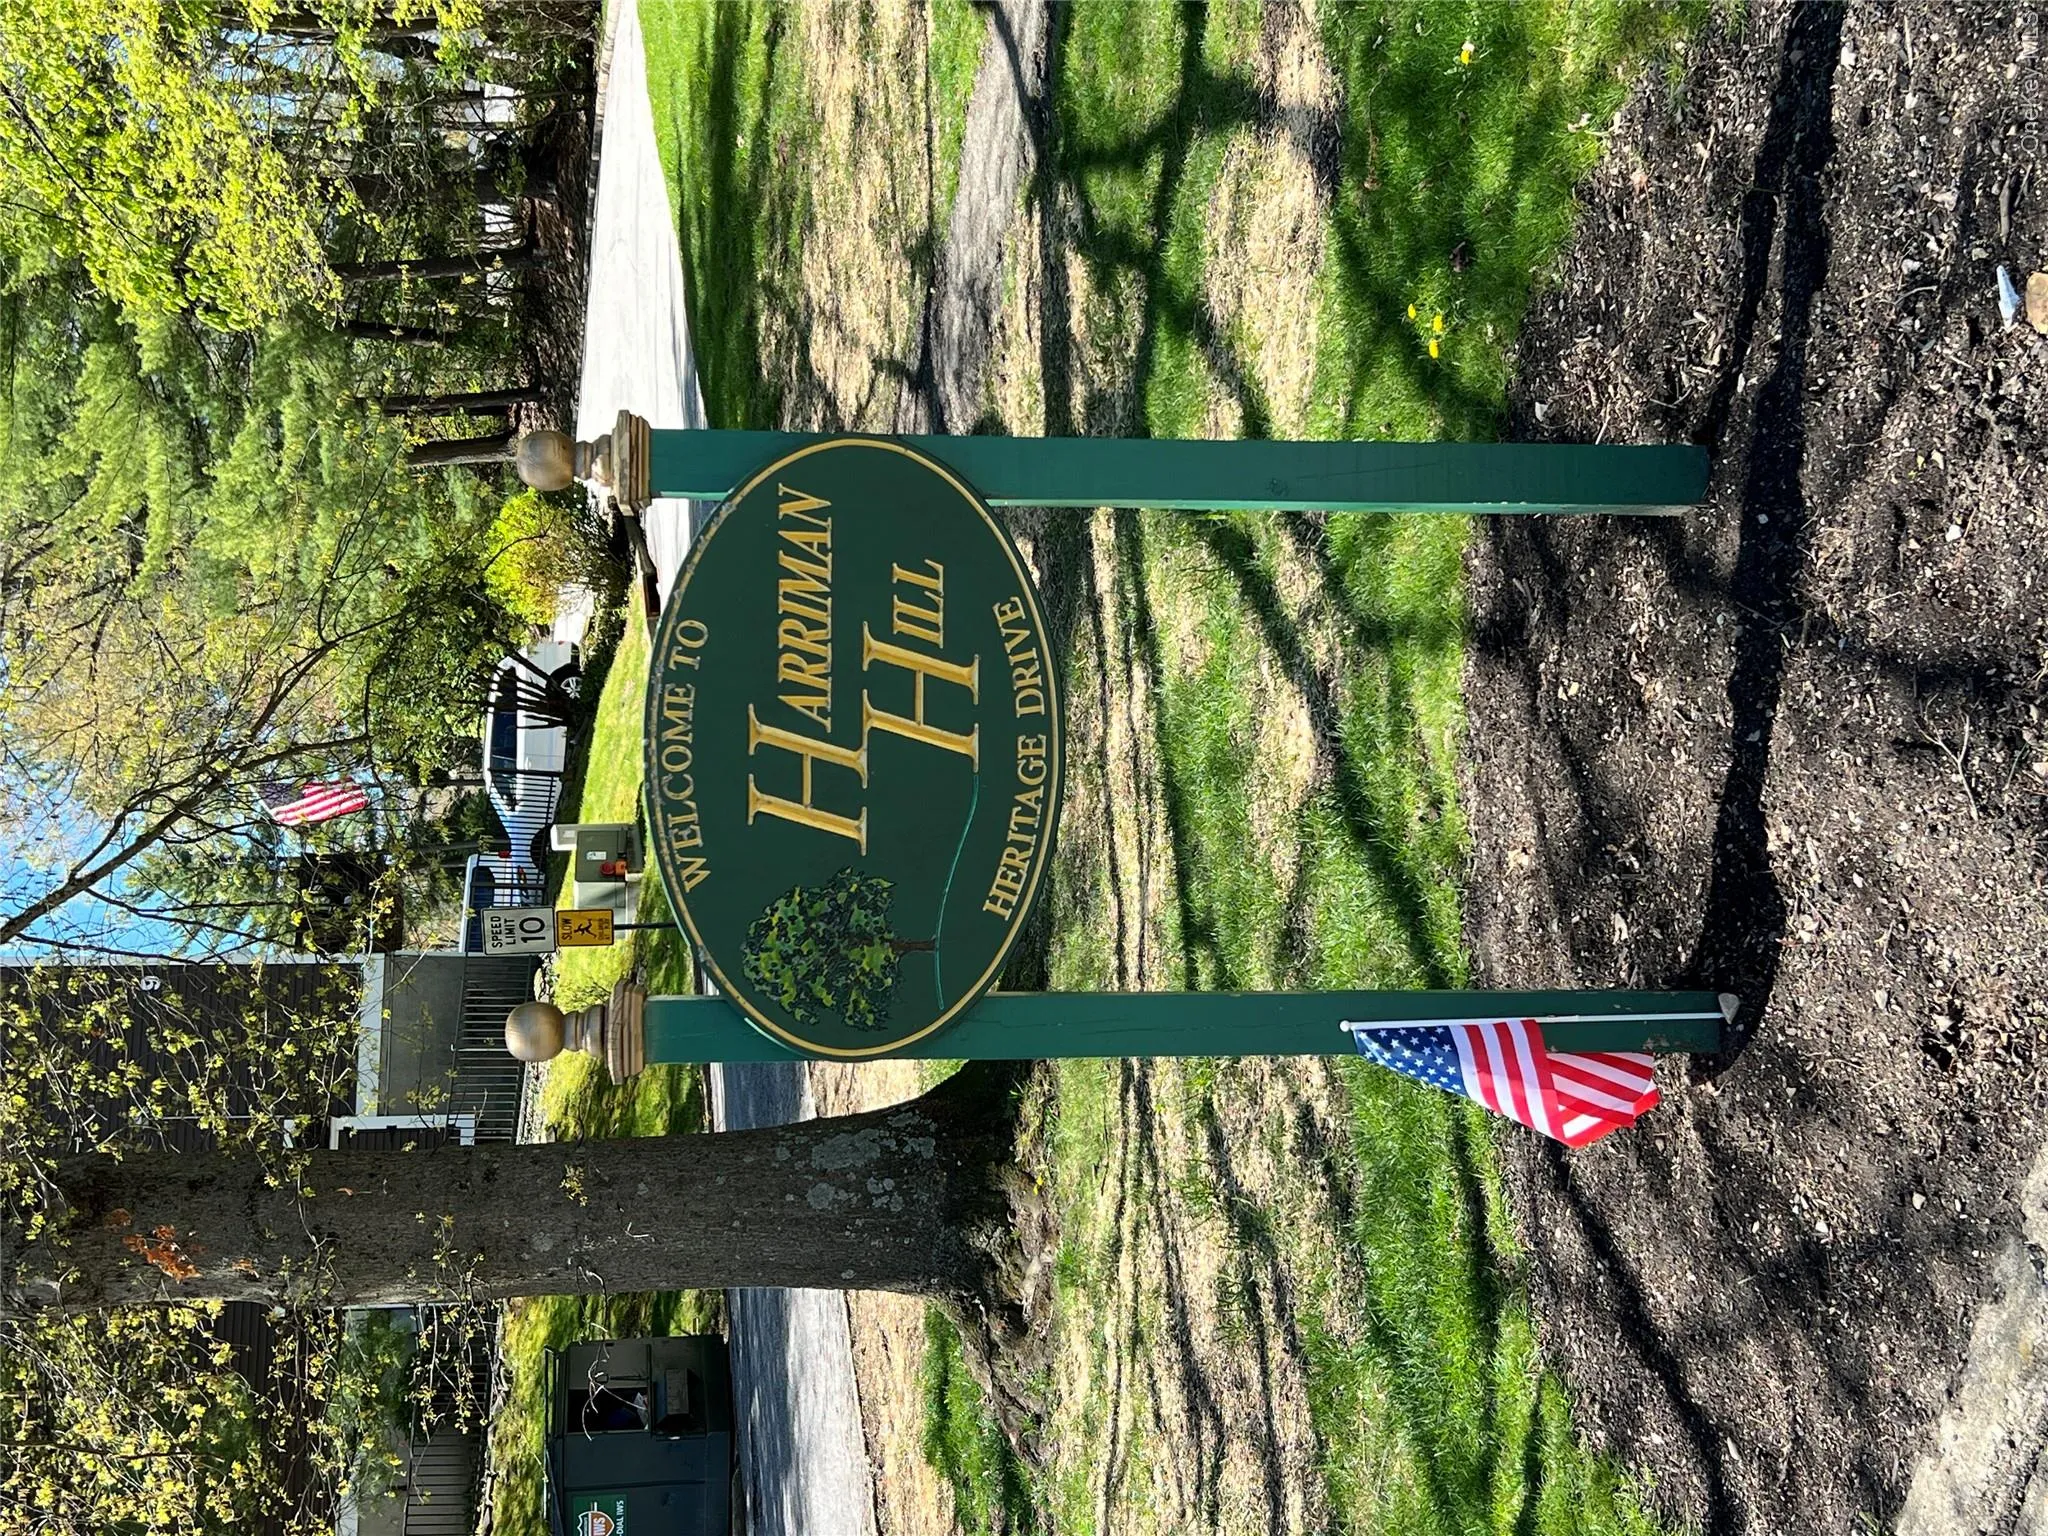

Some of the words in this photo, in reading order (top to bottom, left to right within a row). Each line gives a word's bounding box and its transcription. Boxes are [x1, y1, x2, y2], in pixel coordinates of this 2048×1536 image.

[669, 619, 709, 671] TO
[992, 596, 1046, 719] DRIVE
[747, 484, 868, 856] HARRIMAN
[862, 559, 980, 773] HILL
[661, 682, 711, 892] WELCOME
[983, 734, 1048, 921] HERITAGE
[490, 916, 505, 948] SPEED
[504, 919, 516, 945] LIMIT
[519, 917, 546, 943] 10
[561, 918, 573, 940] SLOW
[141, 976, 161, 990] 9
[616, 1500, 624, 1515] IWS
[593, 1517, 606, 1536] IWS
